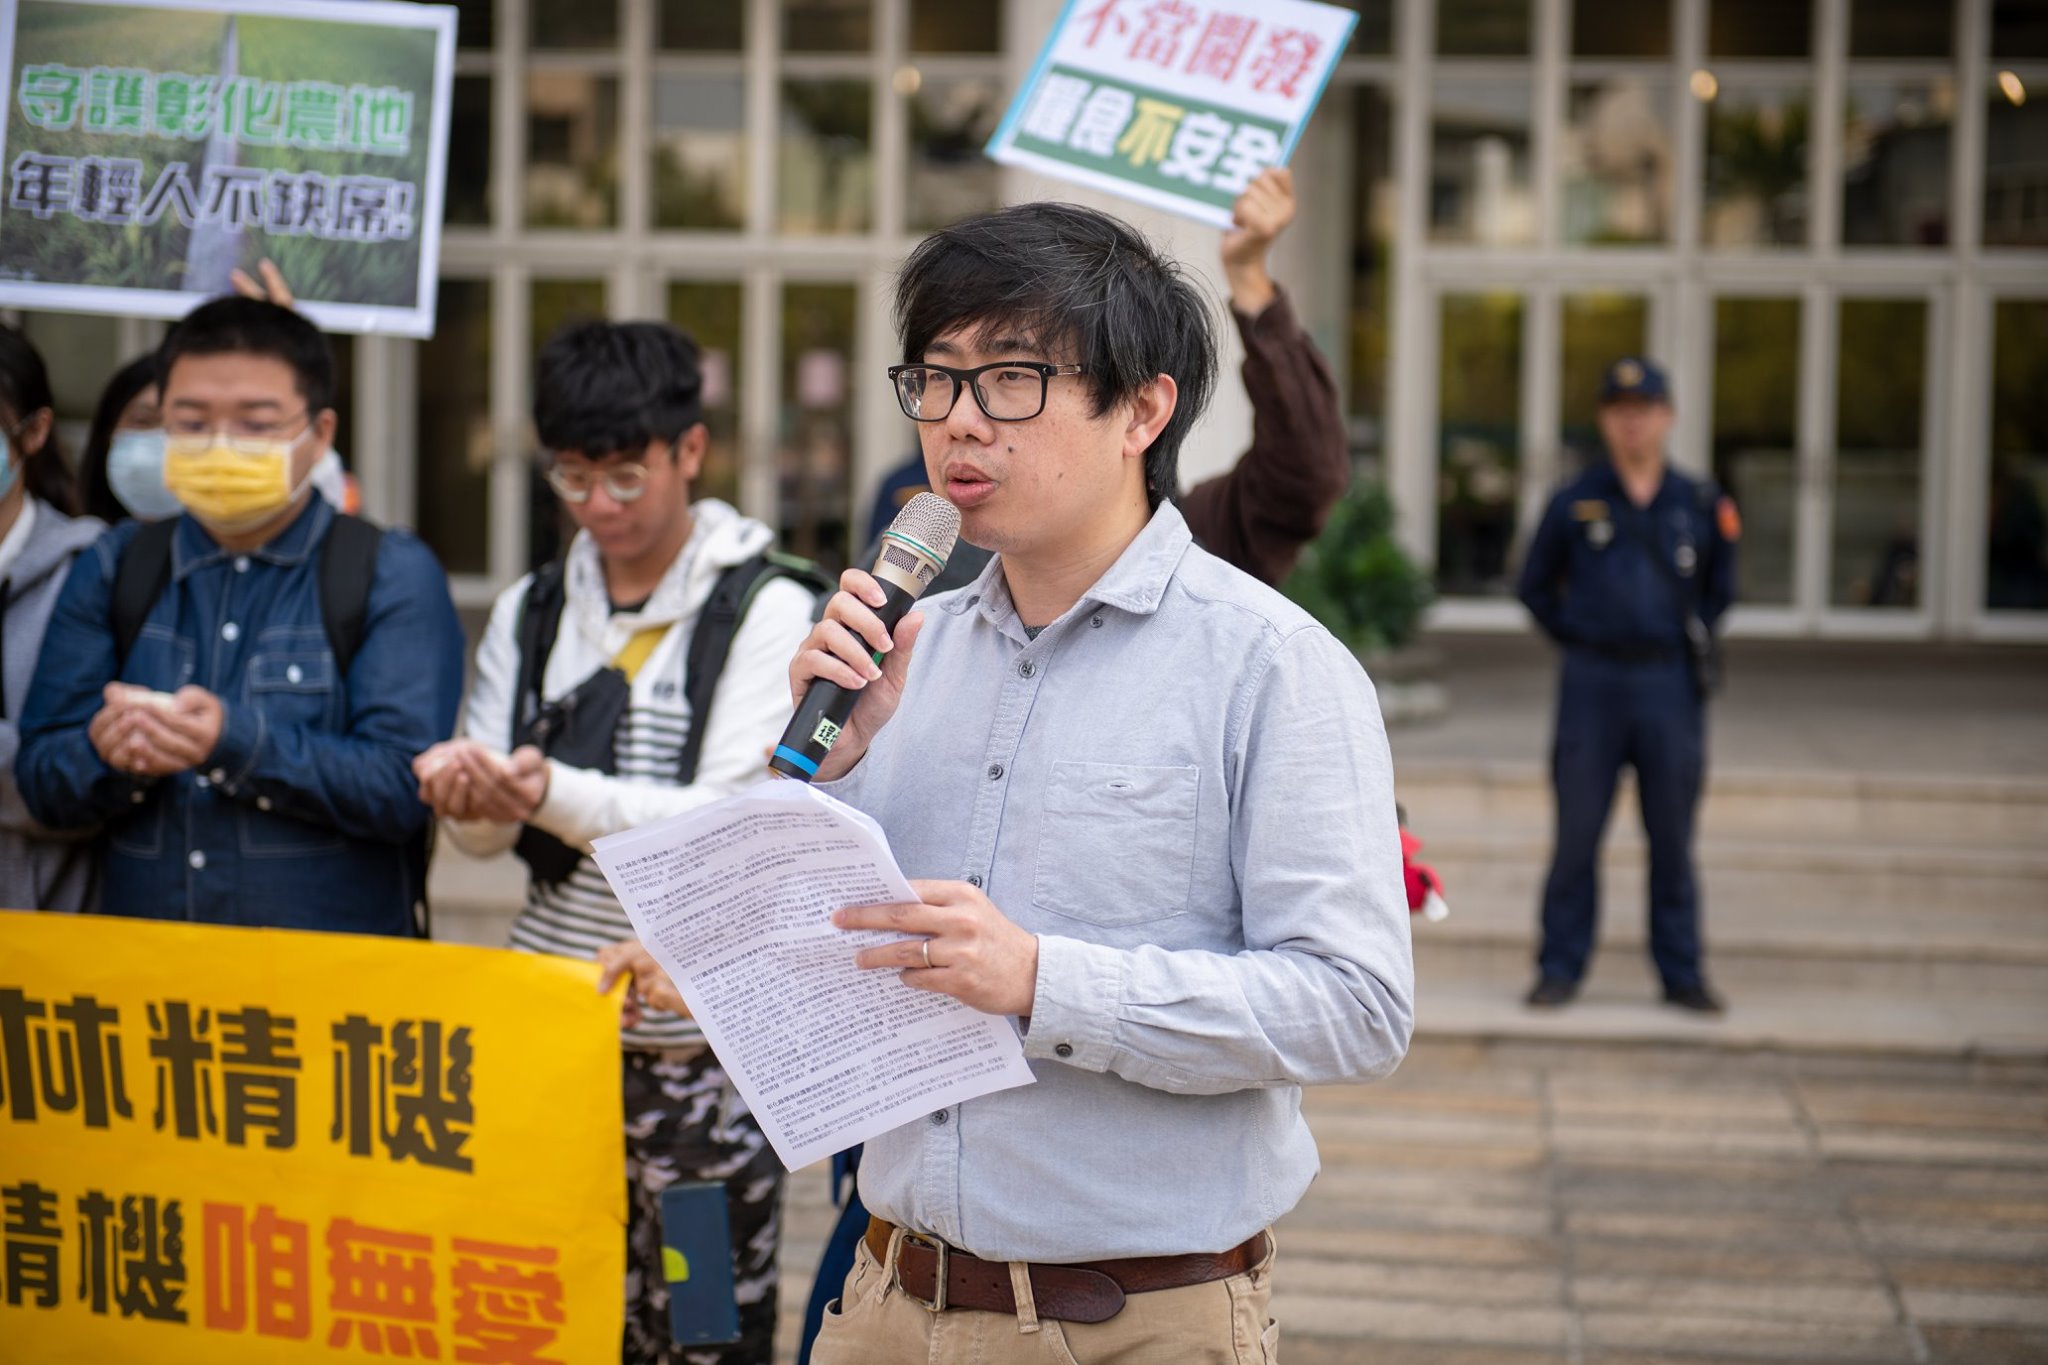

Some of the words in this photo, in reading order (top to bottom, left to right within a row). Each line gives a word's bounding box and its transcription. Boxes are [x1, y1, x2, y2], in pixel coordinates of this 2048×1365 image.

[21, 65, 413, 154] 守護彰化農地
[12, 151, 415, 241] 年輕人不缺席!
[0, 988, 474, 1173] 林精機
